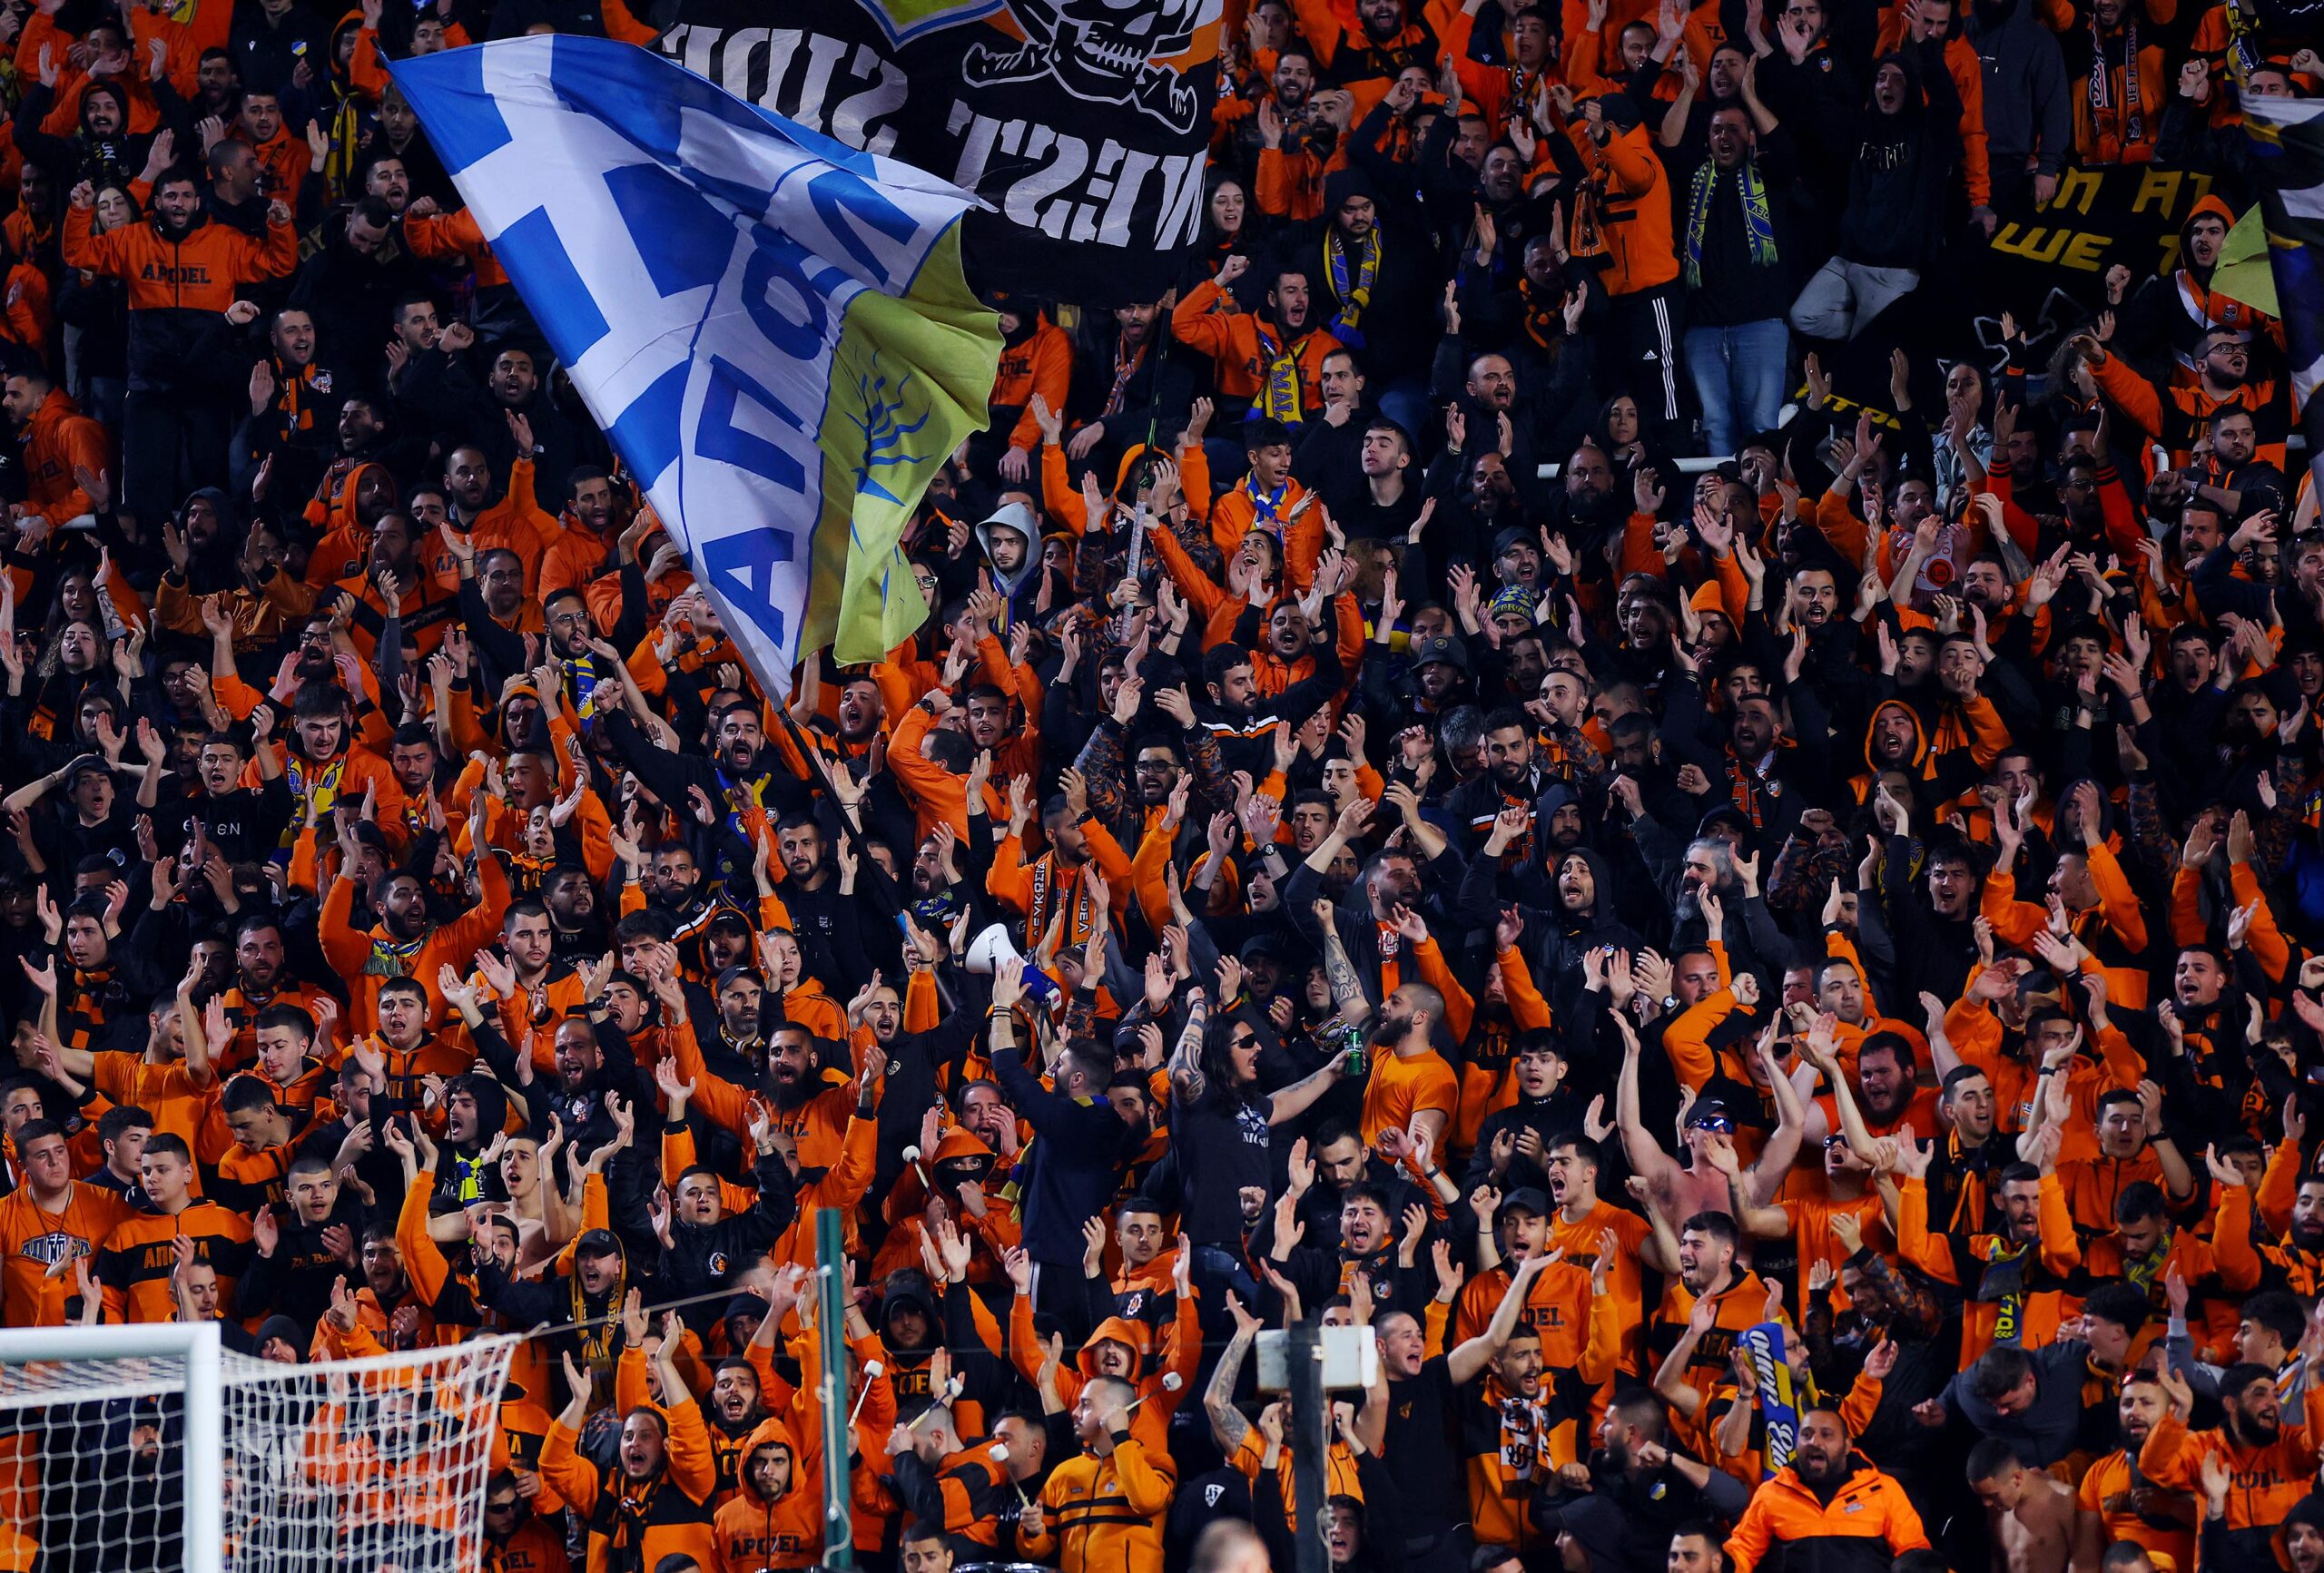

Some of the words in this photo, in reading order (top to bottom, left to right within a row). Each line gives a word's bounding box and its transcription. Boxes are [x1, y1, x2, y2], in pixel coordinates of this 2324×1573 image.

[1991, 221, 2112, 273] WE
[143, 263, 212, 284] APOEL
[729, 1536, 805, 1560] APOEL
